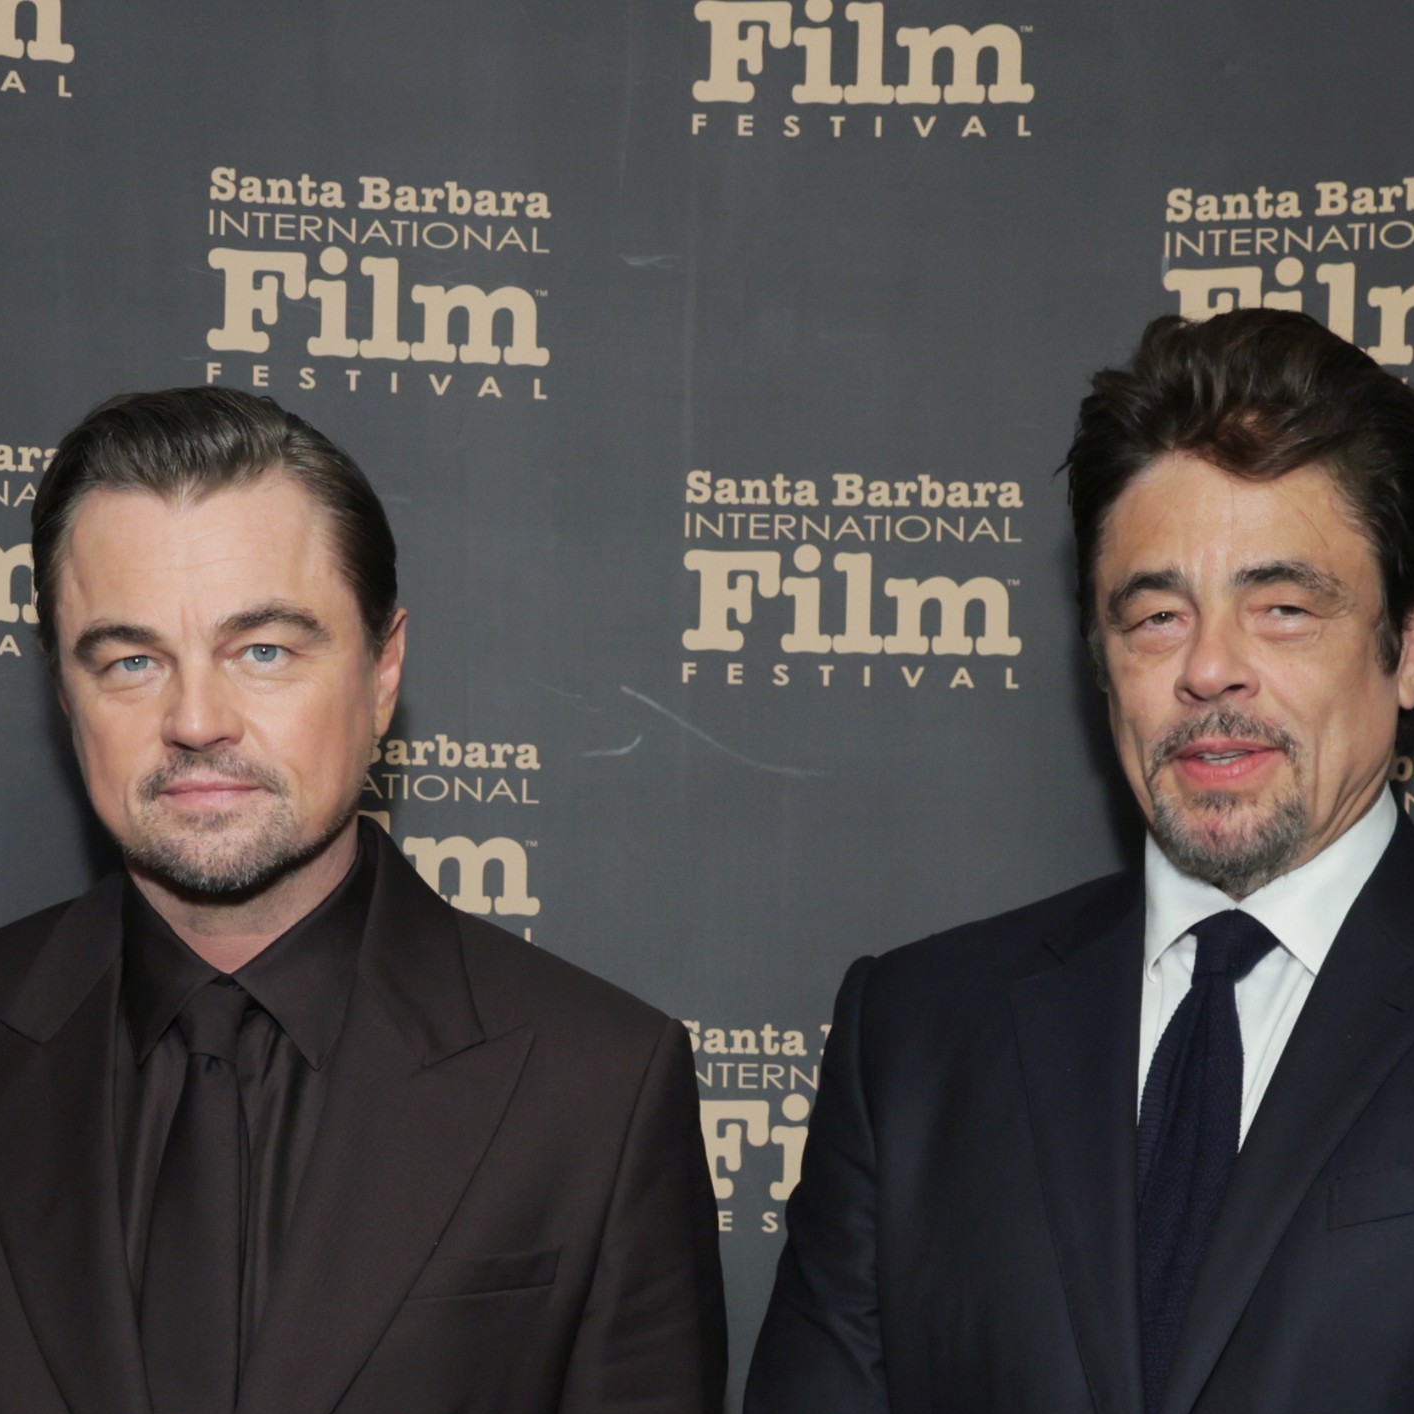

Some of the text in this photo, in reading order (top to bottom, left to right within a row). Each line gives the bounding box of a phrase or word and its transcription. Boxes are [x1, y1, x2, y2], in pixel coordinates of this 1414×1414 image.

[693, 0, 1034, 104] Film
[692, 114, 1031, 137] FESTIVAL
[210, 167, 551, 218] Santa Barbara
[1166, 183, 1301, 223] Santa
[210, 210, 549, 253] INTERNATIONAL
[207, 247, 549, 366] Film
[207, 363, 547, 399] FESTIVAL
[686, 471, 1023, 507] Santa Barbara
[685, 512, 1021, 542] INTERNATIONAL
[682, 544, 1021, 655] Film
[682, 663, 1018, 688] FESTIVAL
